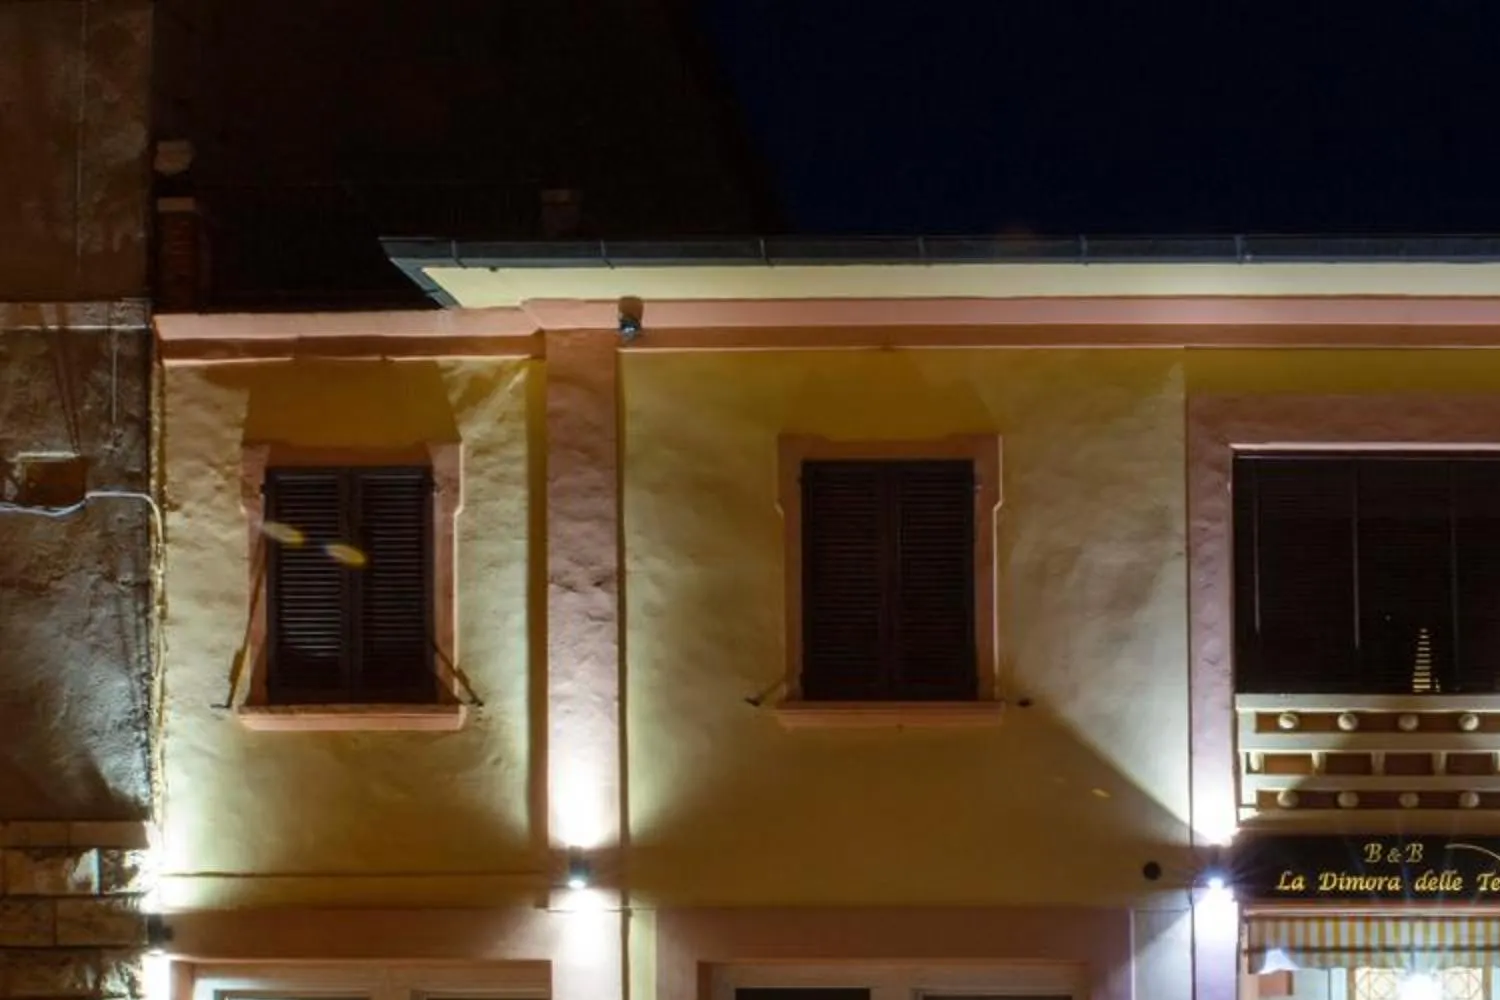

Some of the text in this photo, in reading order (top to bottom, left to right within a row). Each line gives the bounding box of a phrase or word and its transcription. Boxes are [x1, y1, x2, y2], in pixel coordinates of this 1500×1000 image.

[1277, 870, 1305, 891] La
[1318, 871, 1401, 891] Dimora
[1415, 870, 1463, 891] delle
